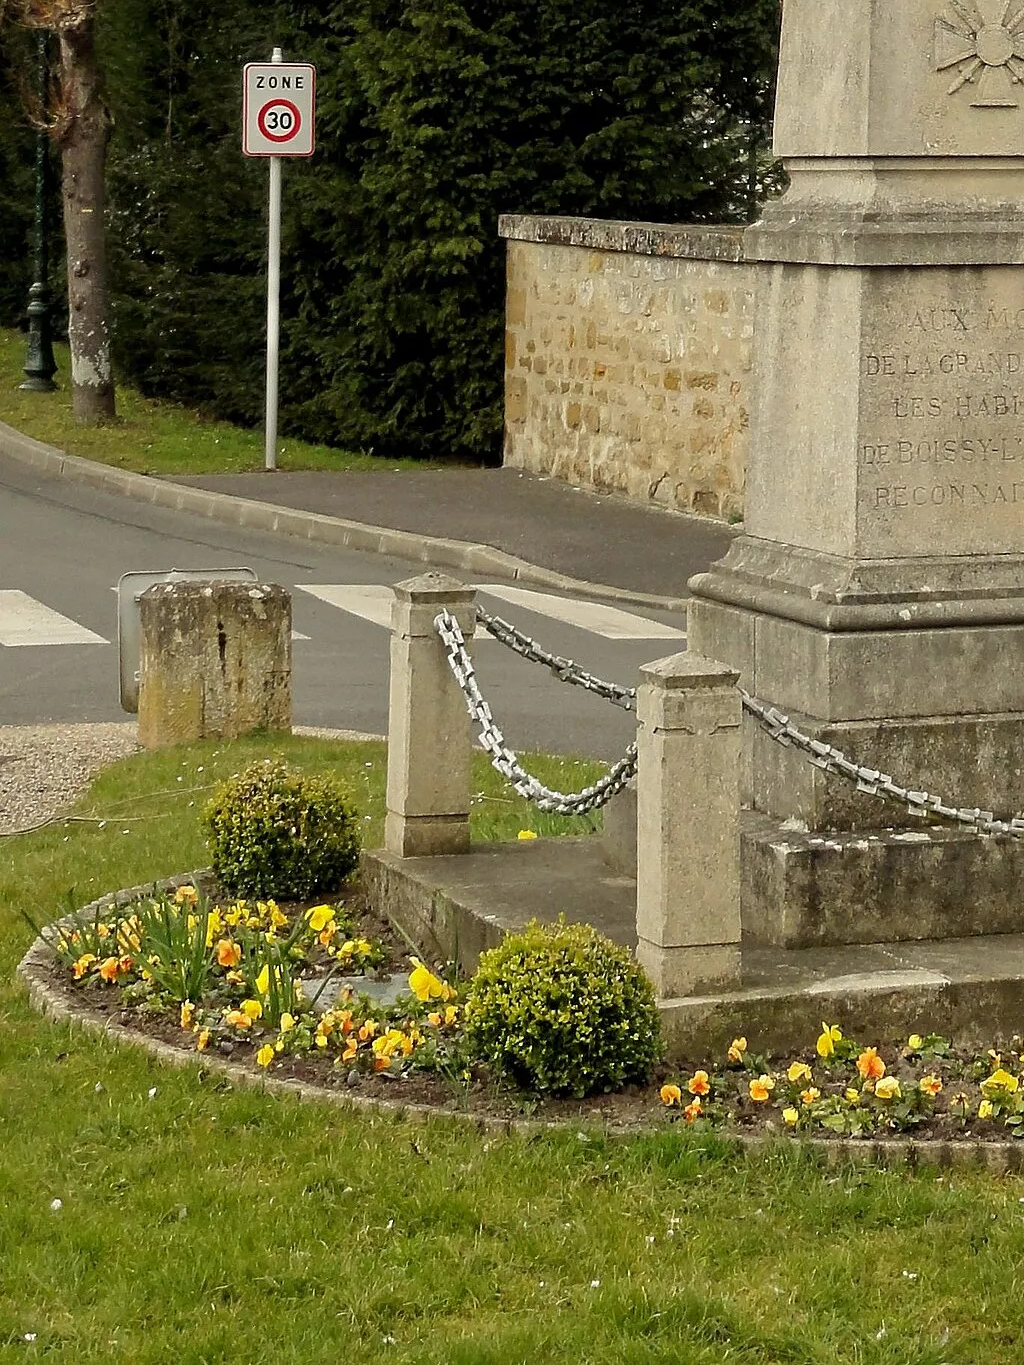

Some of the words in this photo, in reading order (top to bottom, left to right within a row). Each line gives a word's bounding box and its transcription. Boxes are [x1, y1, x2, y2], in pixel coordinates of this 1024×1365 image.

[256, 76, 303, 88] ZONE
[267, 112, 292, 129] 30
[908, 309, 969, 332] AUX
[866, 353, 896, 376] DE
[904, 353, 933, 375] LA
[892, 396, 942, 419] LES
[863, 443, 891, 466] DE
